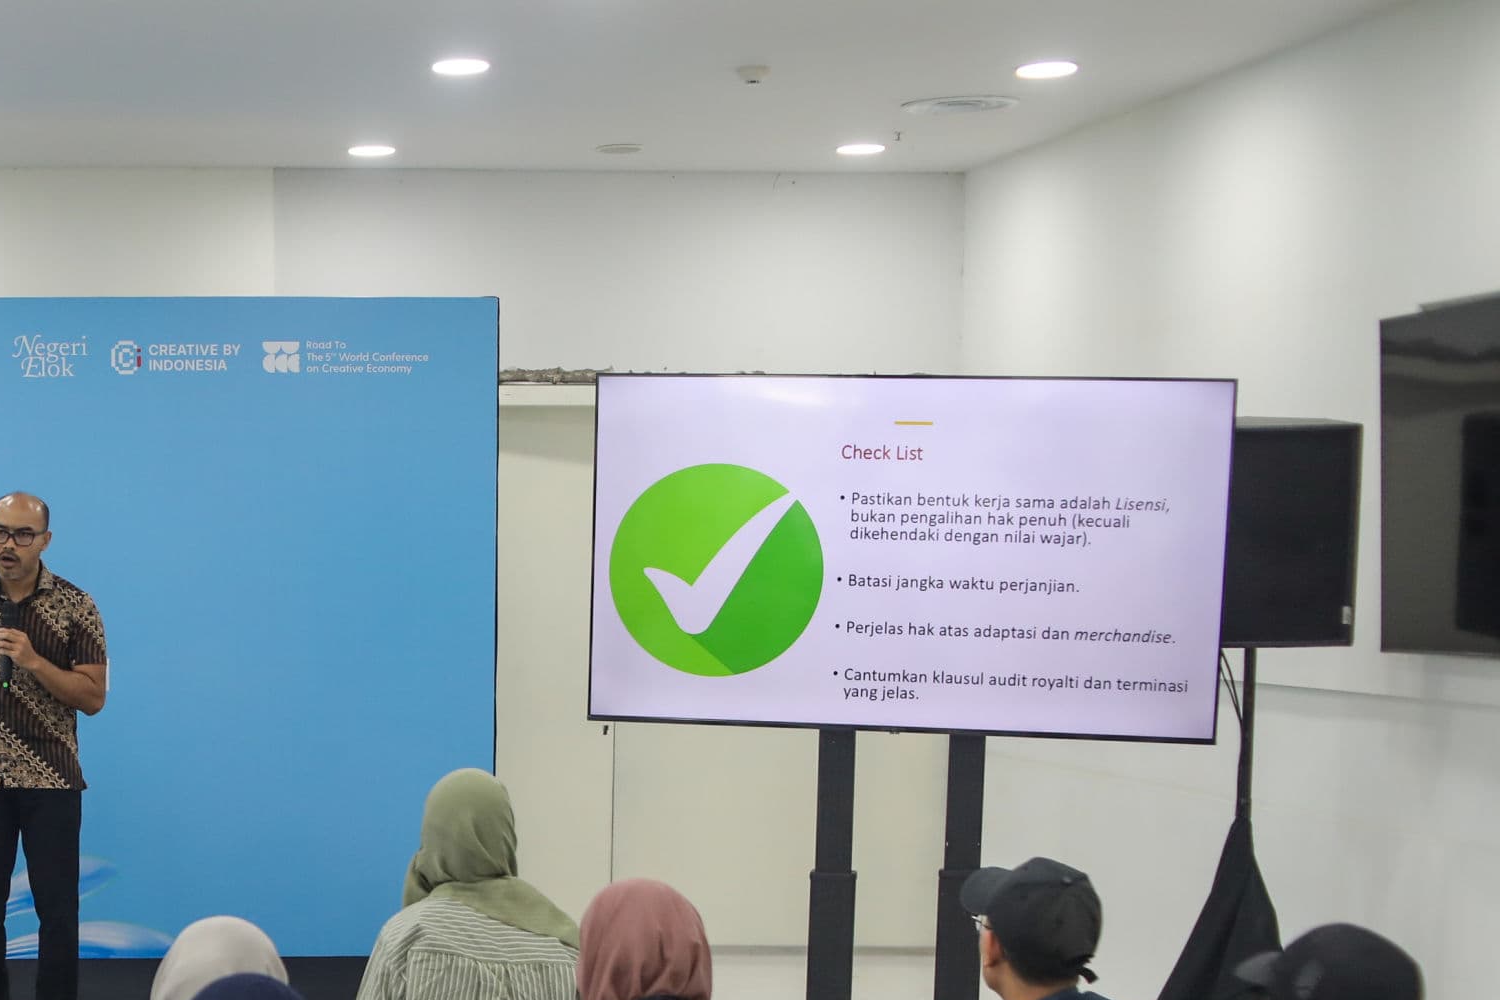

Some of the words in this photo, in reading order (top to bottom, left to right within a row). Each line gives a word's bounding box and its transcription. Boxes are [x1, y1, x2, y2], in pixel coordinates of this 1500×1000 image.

[11, 334, 88, 363] Negeri
[148, 343, 219, 356] CREATIVE
[222, 343, 241, 356] BY
[305, 339, 332, 350] Road
[333, 340, 347, 350] To
[148, 359, 228, 371] INDONESIA
[306, 352, 325, 362] The
[338, 352, 370, 362] World
[371, 351, 429, 362] Conference
[20, 357, 74, 378] Elok
[306, 365, 320, 373] on
[321, 363, 364, 373] Creative
[366, 363, 413, 375] Economy
[841, 445, 891, 460] Check
[896, 446, 924, 461] List
[851, 492, 912, 506] Pastikan
[917, 493, 970, 507] bentuk
[974, 495, 1011, 511] kerja
[1015, 499, 1055, 509] sama
[1059, 497, 1111, 510] adalah
[1115, 498, 1170, 513] Lisensi,
[850, 509, 896, 523] bukan
[900, 510, 982, 527] pengalihan
[987, 512, 1014, 526] hak
[1019, 513, 1067, 530] penuh
[1072, 514, 1130, 530] (kecuali
[850, 526, 939, 541] dikehendaki
[944, 529, 999, 546] dengan
[1004, 529, 1036, 543] nilai
[1039, 532, 1091, 548] wajar).
[848, 574, 892, 588] Batasi
[895, 576, 944, 592] jangka
[949, 577, 994, 591] waktu
[999, 579, 1080, 595] perjanjian.
[846, 621, 904, 638] Perjelas
[908, 623, 935, 636] hak
[938, 626, 969, 637] atas
[973, 625, 1037, 640] adaptasi
[1041, 627, 1070, 641] dan
[1074, 630, 1176, 644] merchandise.
[844, 669, 928, 683] Cantumkan
[932, 671, 984, 686] klausul
[988, 674, 1028, 687] audit
[1031, 676, 1079, 691] royalti
[1083, 677, 1112, 690] dan
[1116, 680, 1189, 693] terminasi
[843, 688, 878, 702] yang
[880, 686, 919, 702] jelas.
